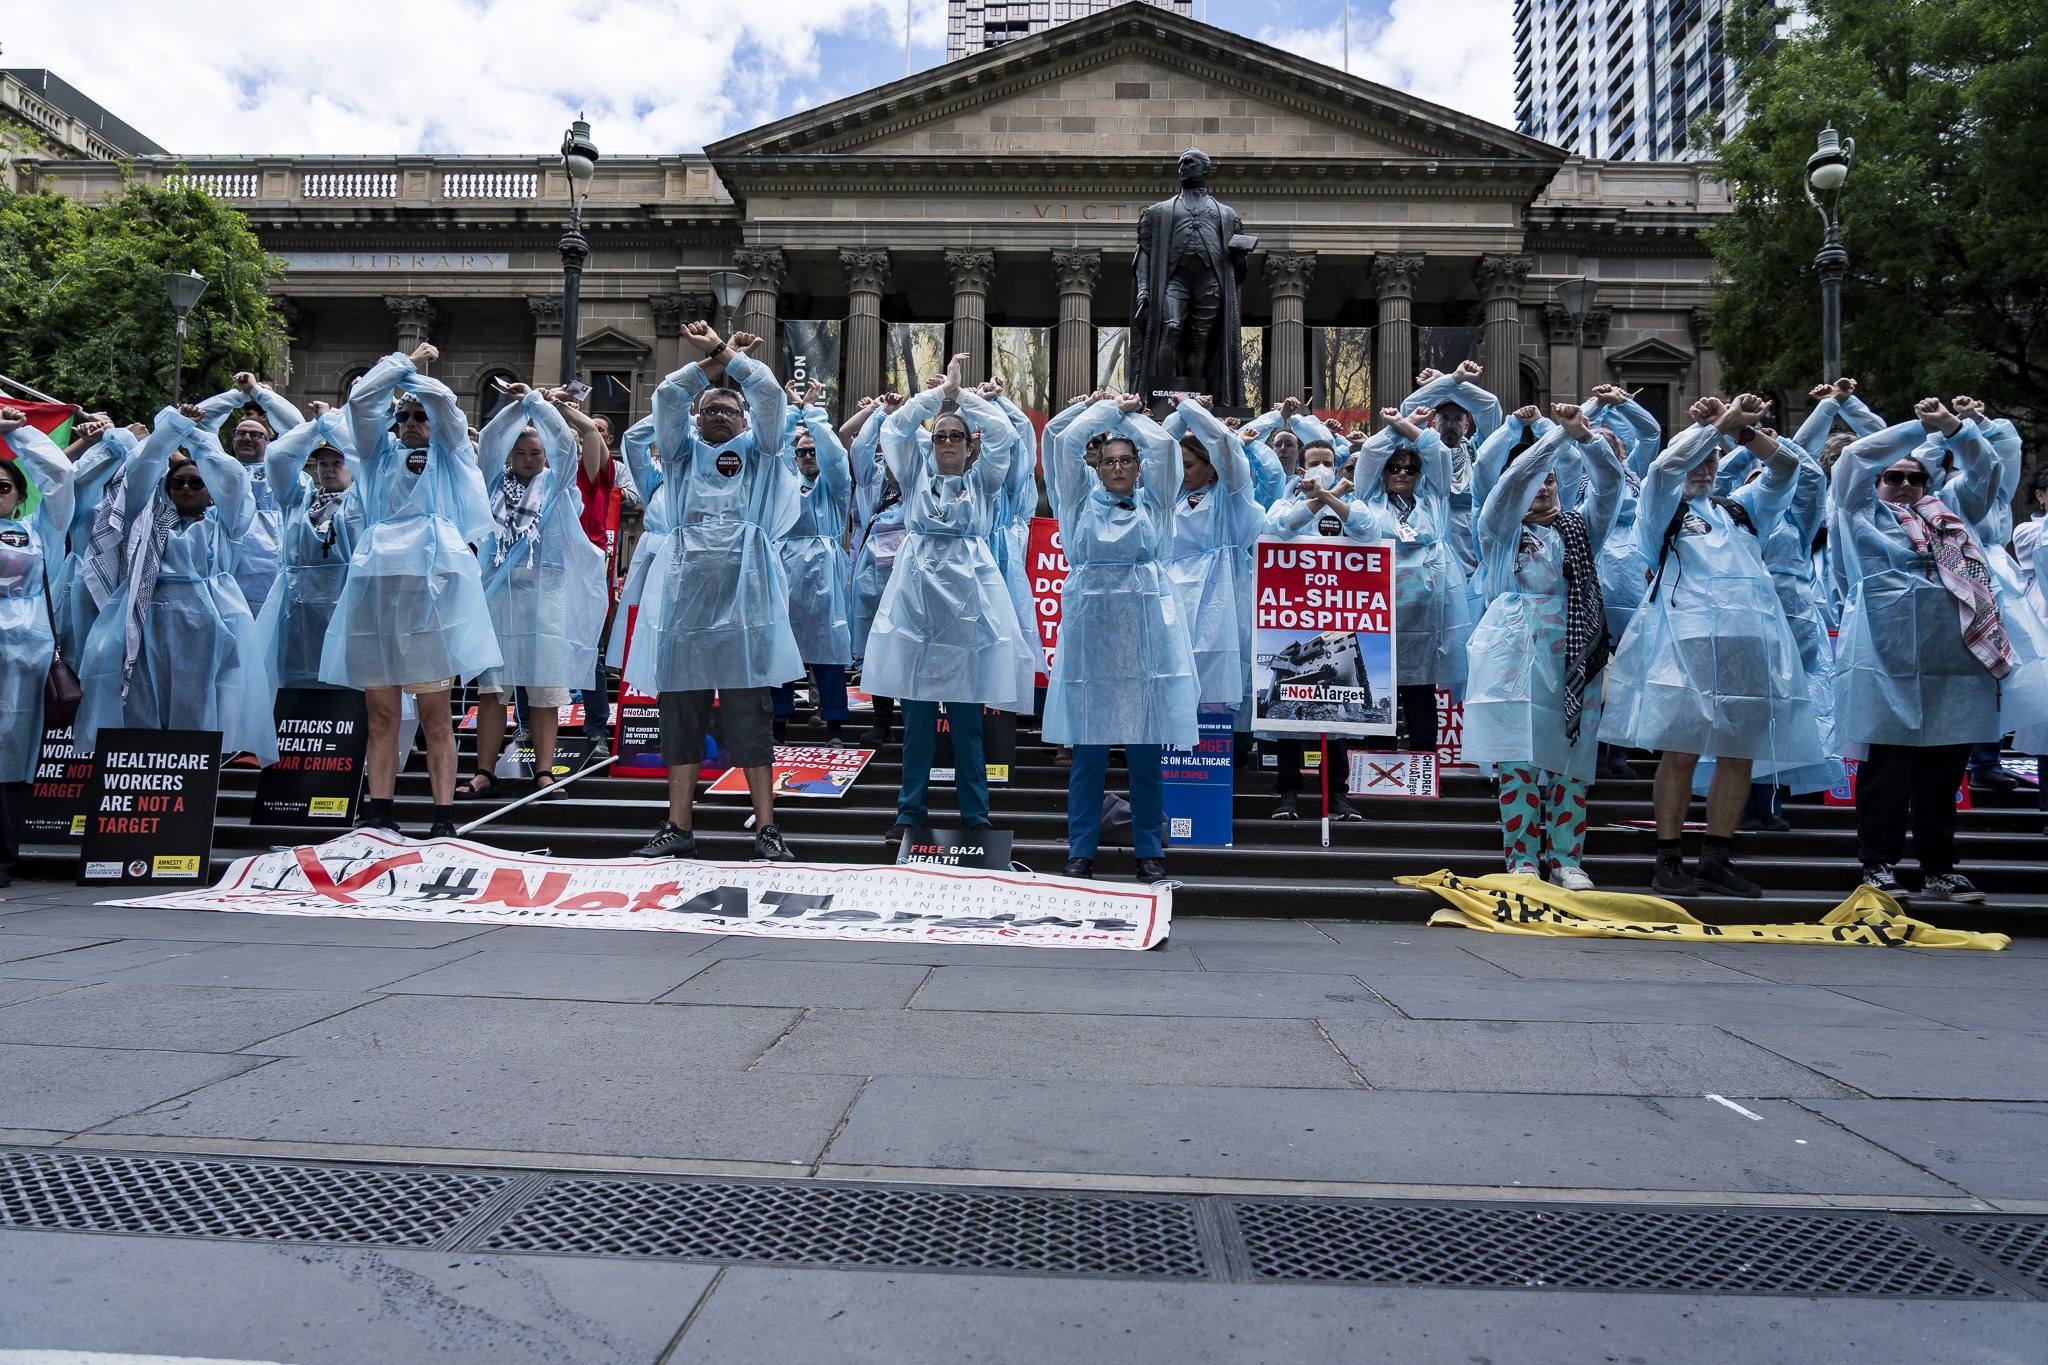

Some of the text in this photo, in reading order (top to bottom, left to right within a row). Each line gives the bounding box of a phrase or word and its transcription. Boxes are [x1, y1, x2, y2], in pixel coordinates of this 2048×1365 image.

[1032, 204, 1148, 220] VICT
[351, 255, 500, 269] LIBRARY
[1264, 549, 1382, 573] JUSTICE
[1305, 573, 1338, 586] FOR
[1259, 587, 1388, 611] AL-SHIFA
[1259, 609, 1389, 632] HOSPITAL
[1280, 685, 1365, 703] #NotATarget
[623, 709, 660, 718] #NotATarg
[278, 720, 354, 735] ATTACKS ON
[277, 738, 322, 752] HEALTH
[106, 752, 209, 770] HEALTHCARE
[272, 756, 353, 772] WAR CRIMES
[772, 762, 858, 772] GENOCIDE
[1170, 756, 1180, 764] ON
[1182, 757, 1230, 766] HEALTHCARE
[36, 763, 93, 779] ARE NOT
[1162, 770, 1208, 780] WAR CRIMES
[1407, 754, 1420, 796] #NotATarget
[1422, 755, 1432, 796] CHILDREN
[104, 773, 184, 790] WORKERS
[33, 782, 84, 798] TARGET
[100, 796, 184, 812] ARE NOT A
[98, 817, 160, 834] TARGET
[910, 845, 984, 856] FREE GAZA
[908, 854, 960, 865] HEALTH
